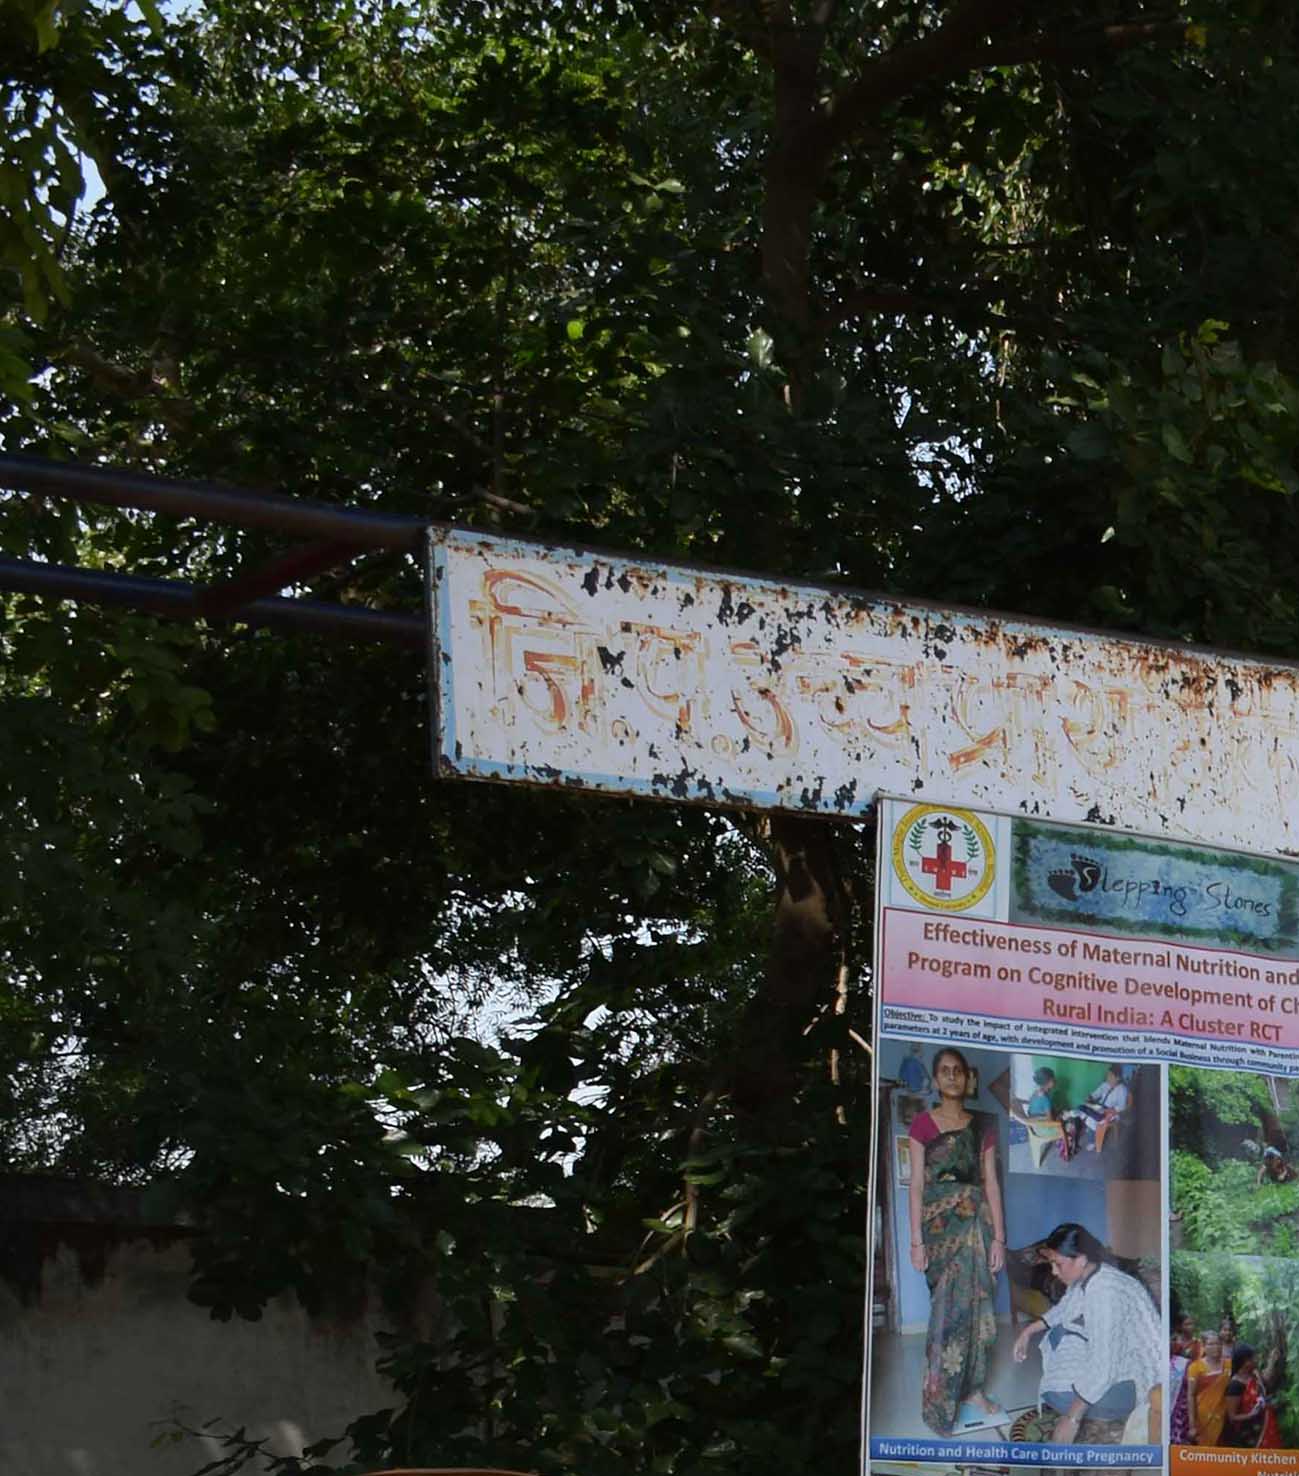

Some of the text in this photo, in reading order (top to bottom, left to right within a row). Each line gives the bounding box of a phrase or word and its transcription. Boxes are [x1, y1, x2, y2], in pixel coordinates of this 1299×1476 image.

[1080, 864, 1271, 917] Stepping Stones
[923, 921, 1052, 955] Effectiveness
[1057, 940, 1079, 958] of
[1082, 943, 1171, 969] Maternal
[1177, 953, 1260, 982] Nutrition
[907, 951, 991, 979] Program
[997, 966, 1022, 983] on
[1028, 966, 1118, 993] Cognitive
[1124, 977, 1252, 1009] Development
[1258, 995, 1277, 1012] of
[884, 1008, 925, 1022] Objective:
[928, 1013, 938, 1022] To
[942, 1015, 964, 1026] study
[967, 1018, 980, 1026] the
[983, 1019, 1010, 1032] impact
[1014, 1022, 1024, 1031] of
[1071, 1029, 1119, 1041] intervention
[1122, 1033, 1141, 1042] that
[1143, 1035, 1171, 1045] blends
[1174, 1038, 1207, 1050] Maternal
[1210, 1042, 1247, 1053] Nutrition
[1250, 1046, 1266, 1056] with
[1043, 998, 1284, 1042] Rural India: A Cluster RCT
[884, 1023, 930, 1034] parameters
[950, 1030, 970, 1040] years
[972, 1031, 981, 1039] of
[982, 1034, 999, 1043] age,
[1001, 1034, 1018, 1044] with
[1021, 1036, 1075, 1049] development
[1076, 1042, 1090, 1050] and
[1092, 1043, 1136, 1055] promotion
[1137, 1047, 1147, 1055] of
[1156, 1048, 1177, 1057] Social
[1180, 1051, 1211, 1062] Business
[1213, 1054, 1244, 1066] through
[1247, 1059, 1287, 1072] community
[879, 1443, 1153, 1464] Nutrition and Health Care During Pregnancy
[1180, 1449, 1296, 1465] Community Kitchen
